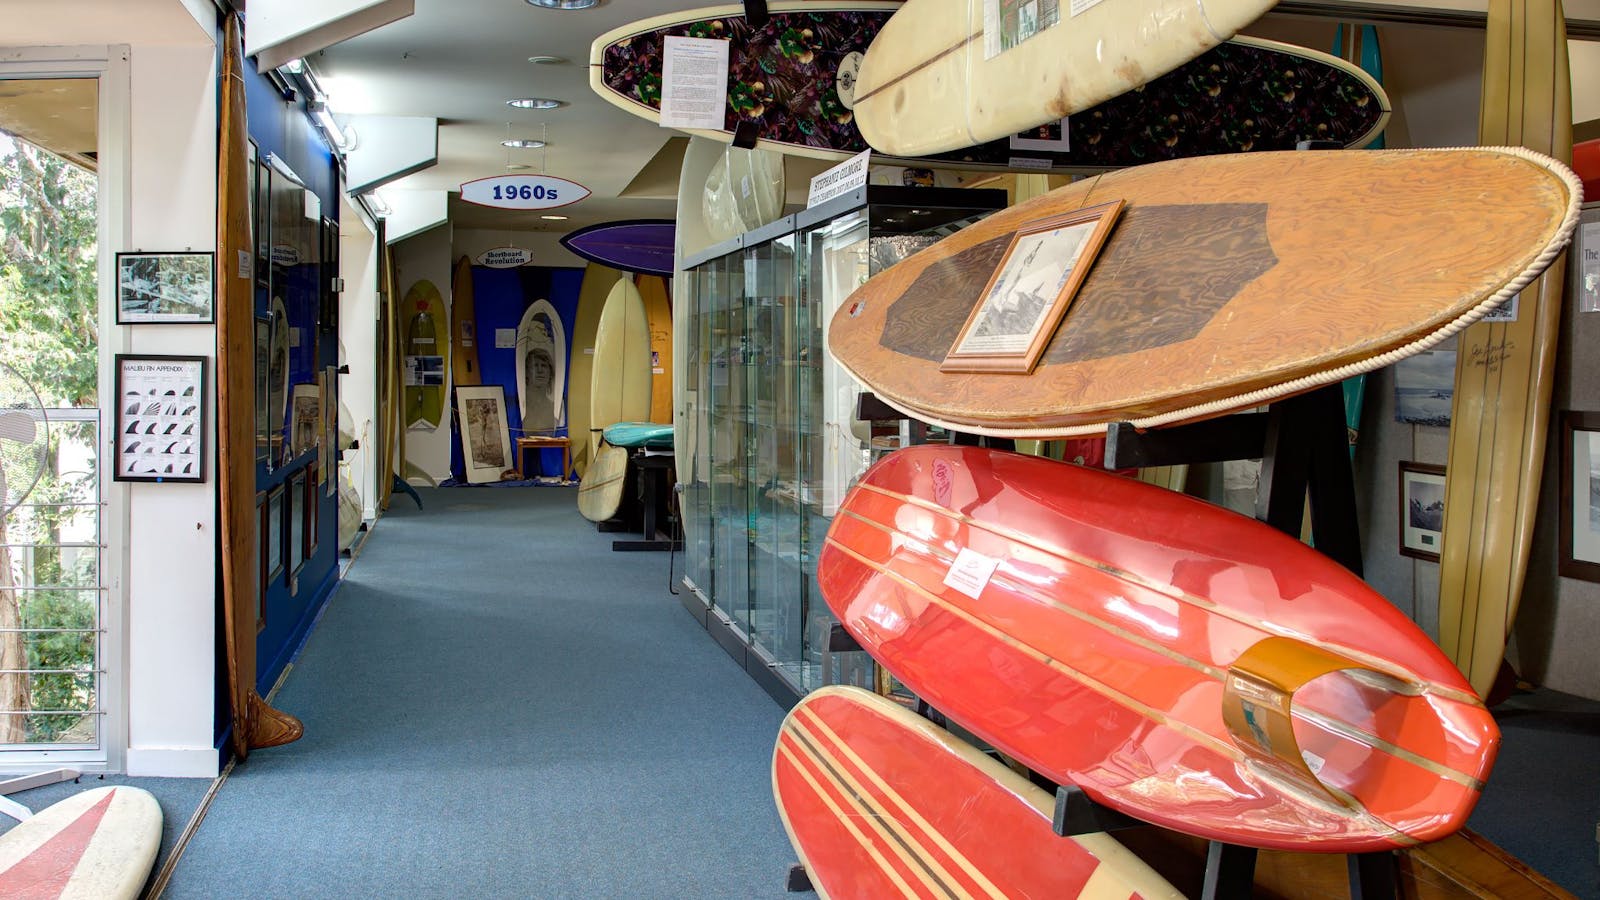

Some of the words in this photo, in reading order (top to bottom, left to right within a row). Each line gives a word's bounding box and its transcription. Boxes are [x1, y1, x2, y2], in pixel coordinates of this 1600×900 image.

[493, 185, 558, 200] 1960s
[485, 257, 525, 265] Revolution
[1584, 248, 1599, 261] The
